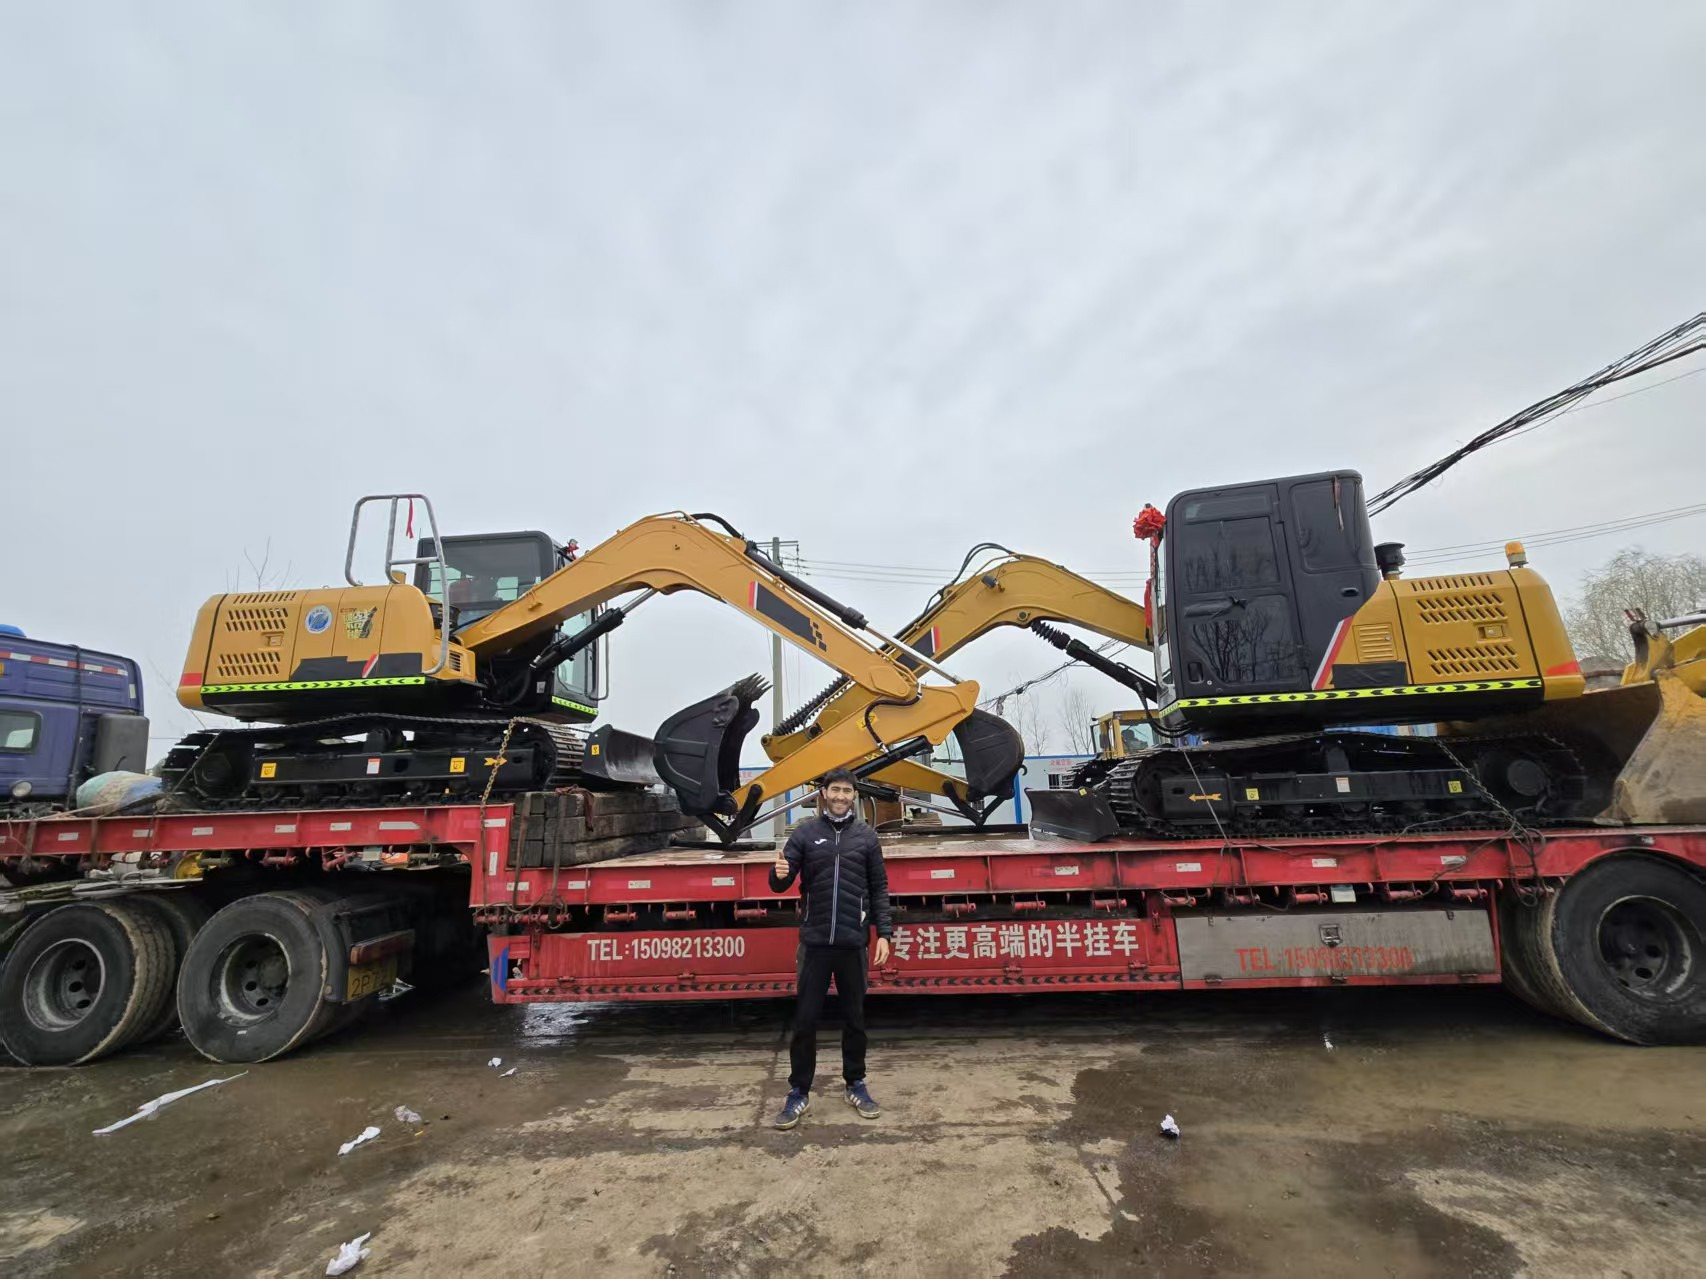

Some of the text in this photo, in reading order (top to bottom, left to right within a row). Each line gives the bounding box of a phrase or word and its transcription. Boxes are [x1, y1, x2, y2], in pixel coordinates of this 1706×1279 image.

[587, 936, 745, 961] TEL:15098213300
[891, 922, 1139, 961] 专注更高端的半挂车
